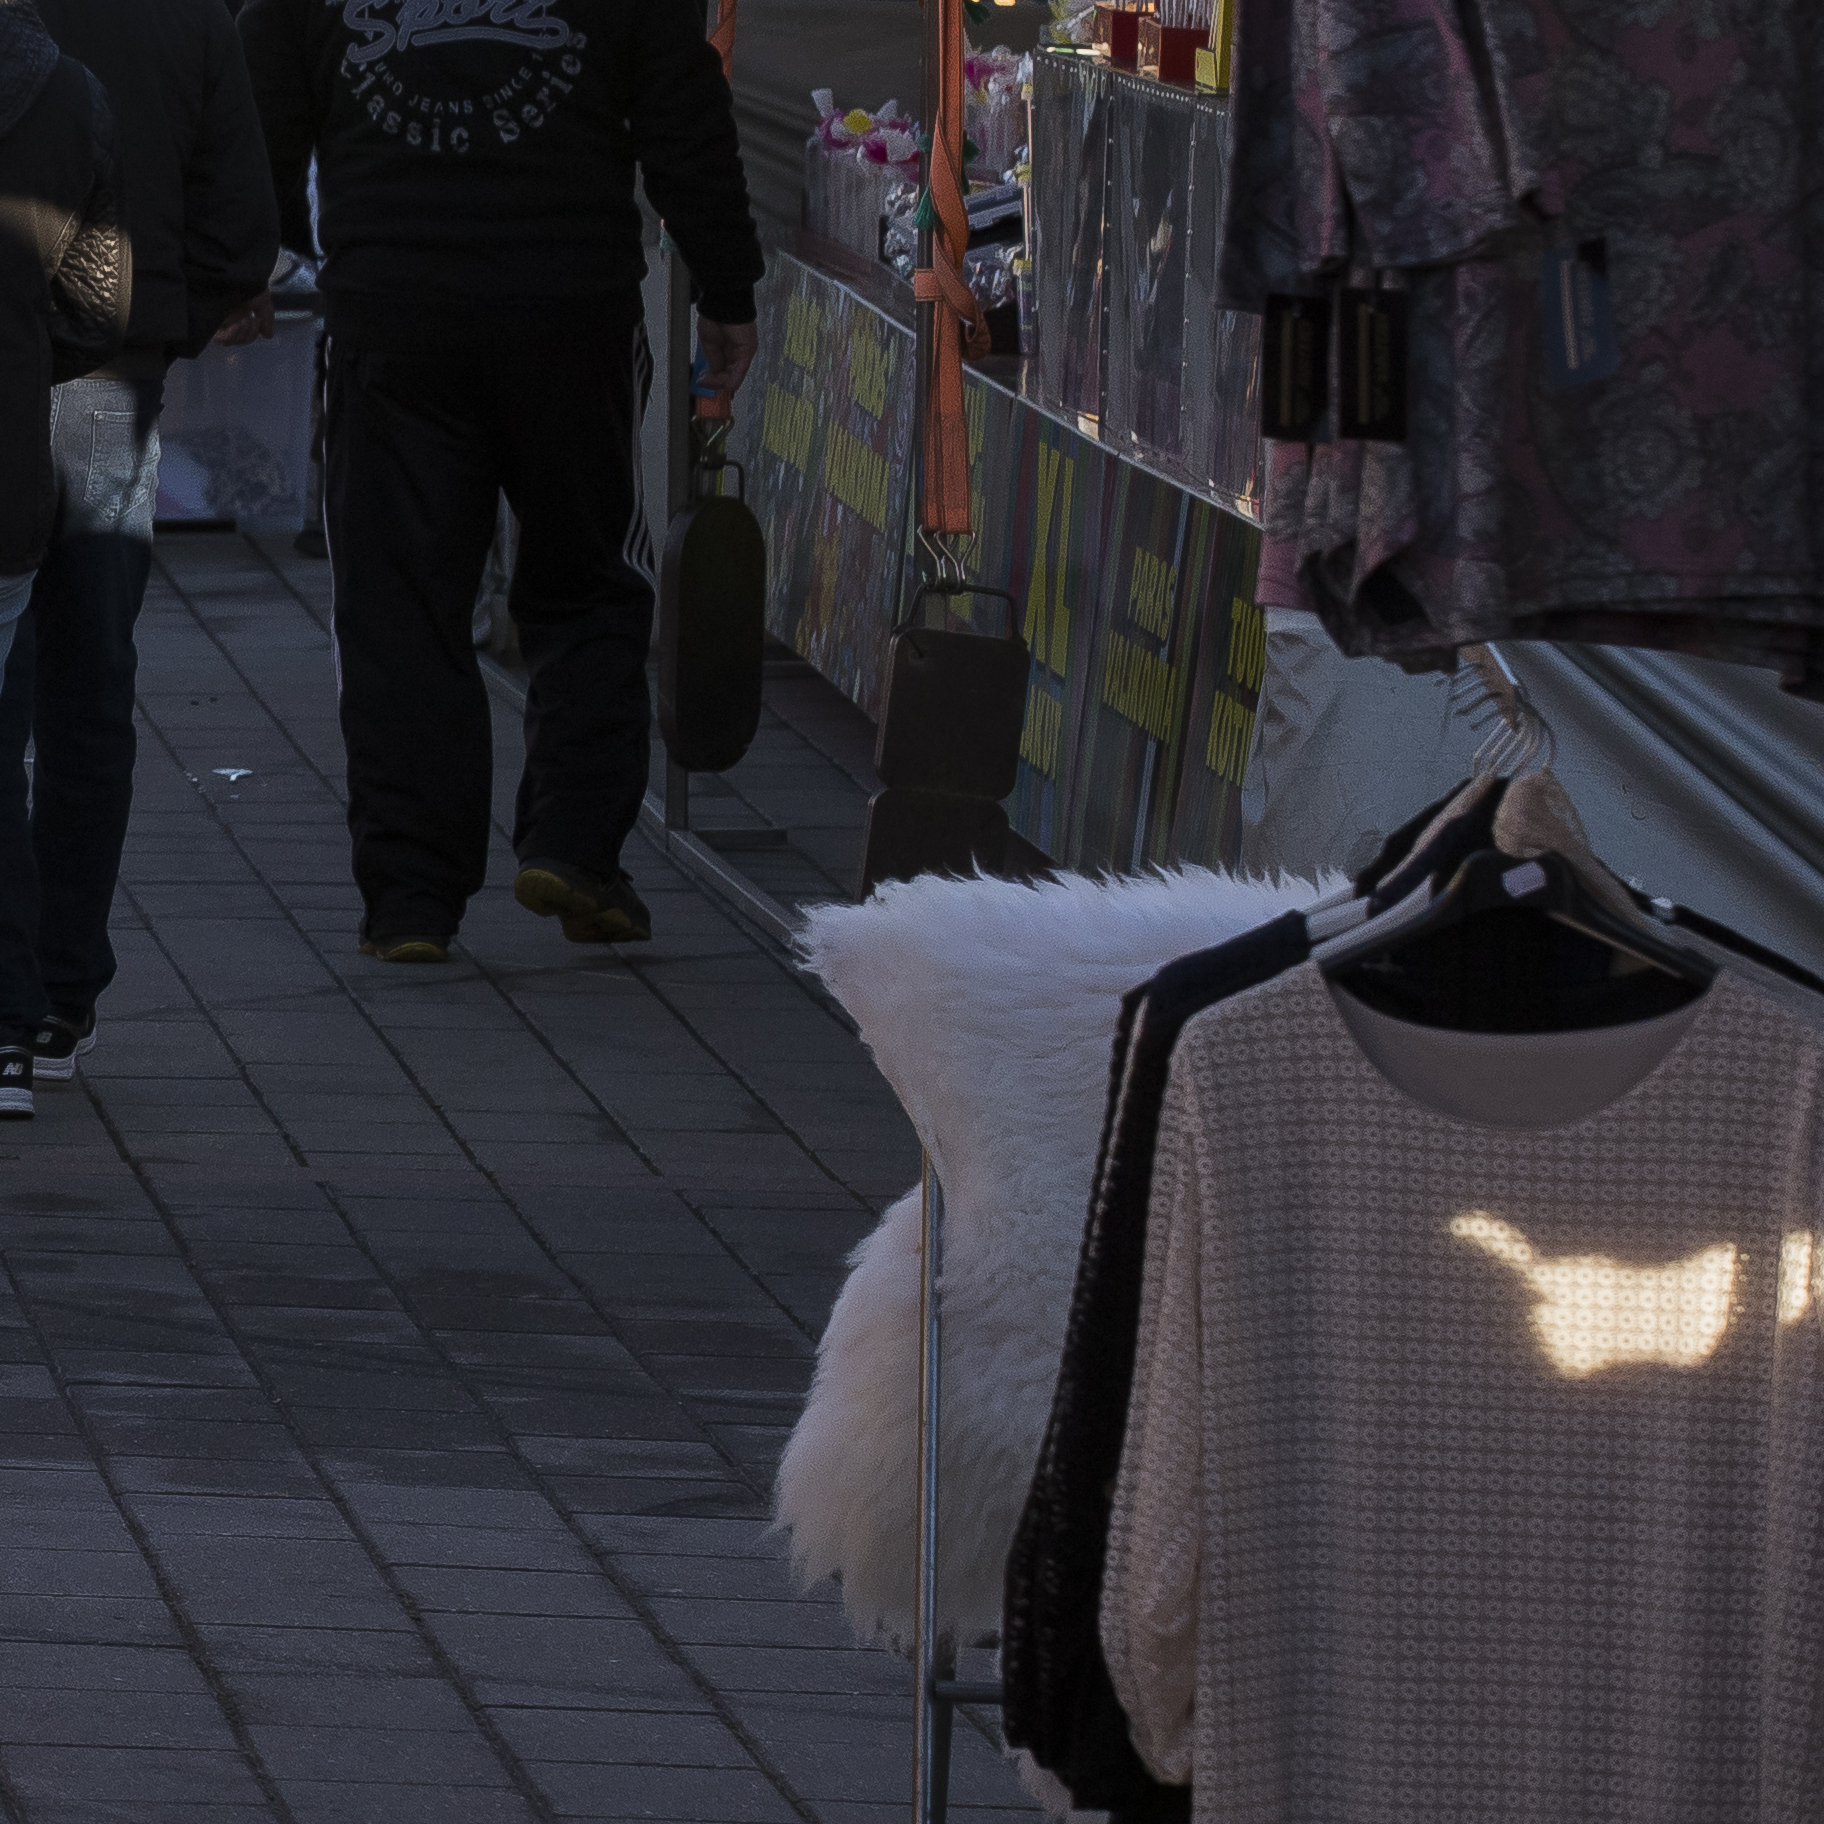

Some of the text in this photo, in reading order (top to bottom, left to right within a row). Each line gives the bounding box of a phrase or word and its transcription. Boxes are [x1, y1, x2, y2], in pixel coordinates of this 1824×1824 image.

[1022, 441, 1075, 678] XL
[1127, 545, 1178, 643] PARAS
[1101, 628, 1177, 746] VALIKOIMA
